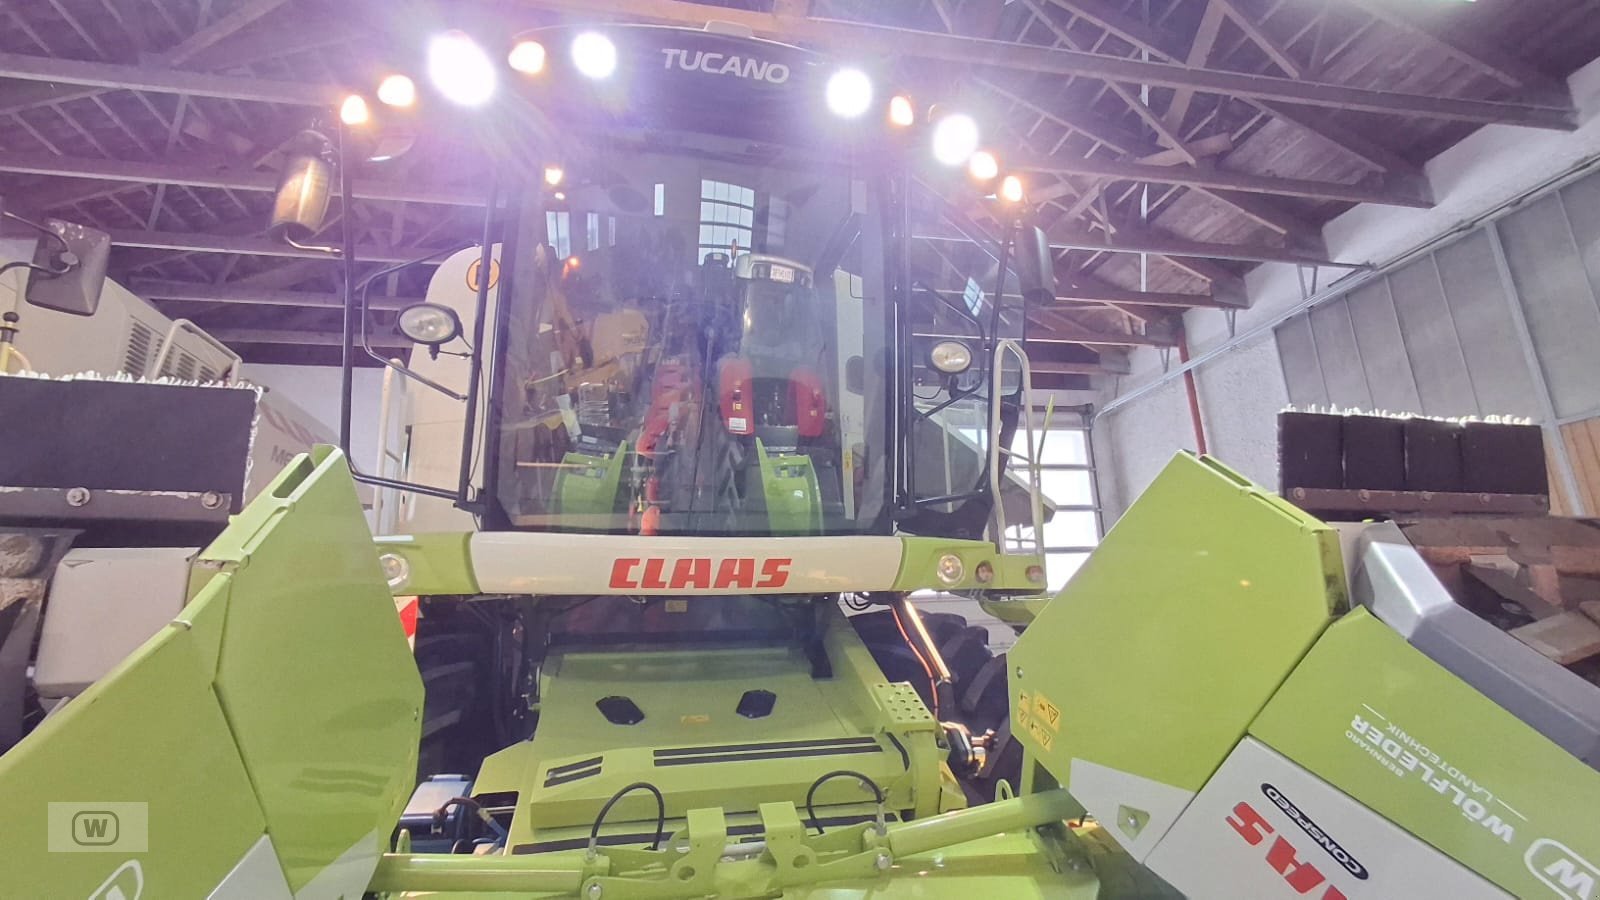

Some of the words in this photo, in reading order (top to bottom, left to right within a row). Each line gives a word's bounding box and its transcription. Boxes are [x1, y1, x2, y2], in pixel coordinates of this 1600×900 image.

[661, 48, 790, 84] TUCANO
[608, 558, 792, 589] CLAAS
[1345, 730, 1405, 778] BERNHARD
[1351, 714, 1515, 845] WÖLFLEDER
[1386, 721, 1494, 802] LANDTECHNIK
[1225, 801, 1348, 900] AS
[1266, 787, 1362, 875] CONSPEED
[1544, 858, 1595, 900] W
